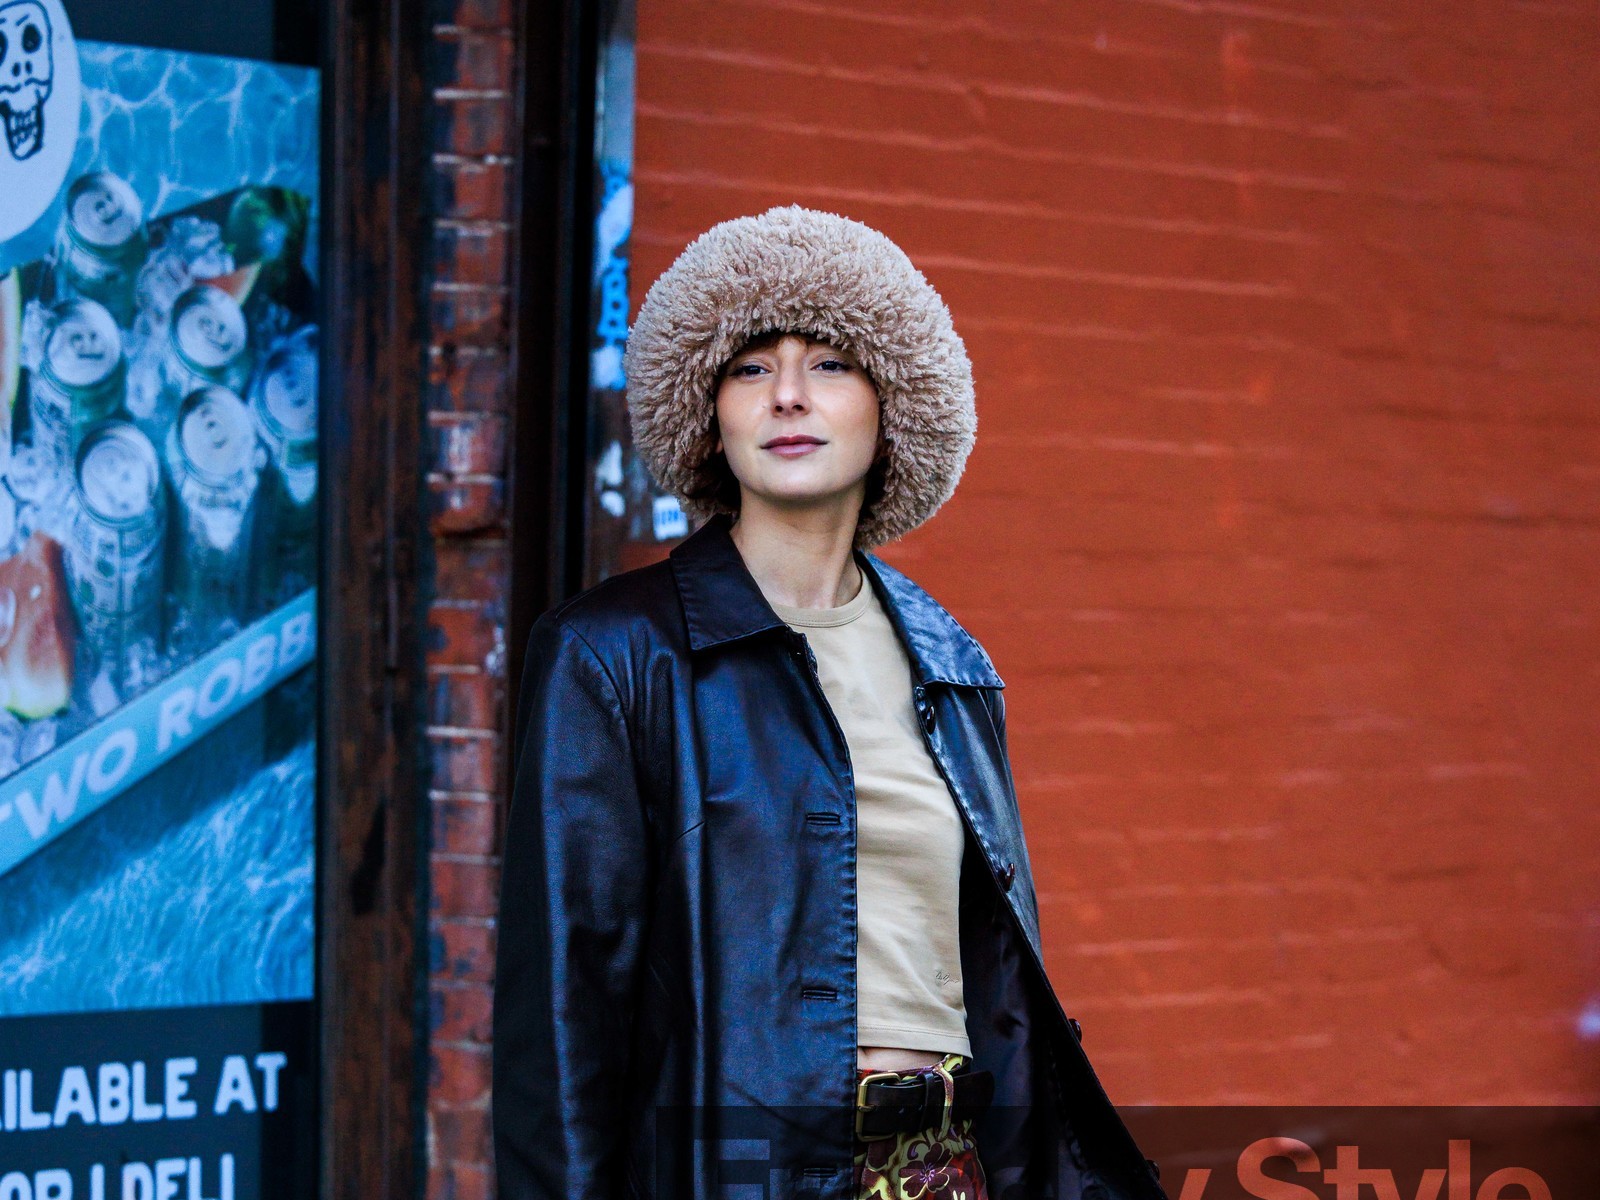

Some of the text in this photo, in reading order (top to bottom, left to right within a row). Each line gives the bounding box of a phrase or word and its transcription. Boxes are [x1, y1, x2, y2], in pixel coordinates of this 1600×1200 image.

[0, 611, 312, 840] WO ROBB
[0, 1051, 288, 1132] ILABLE AT
